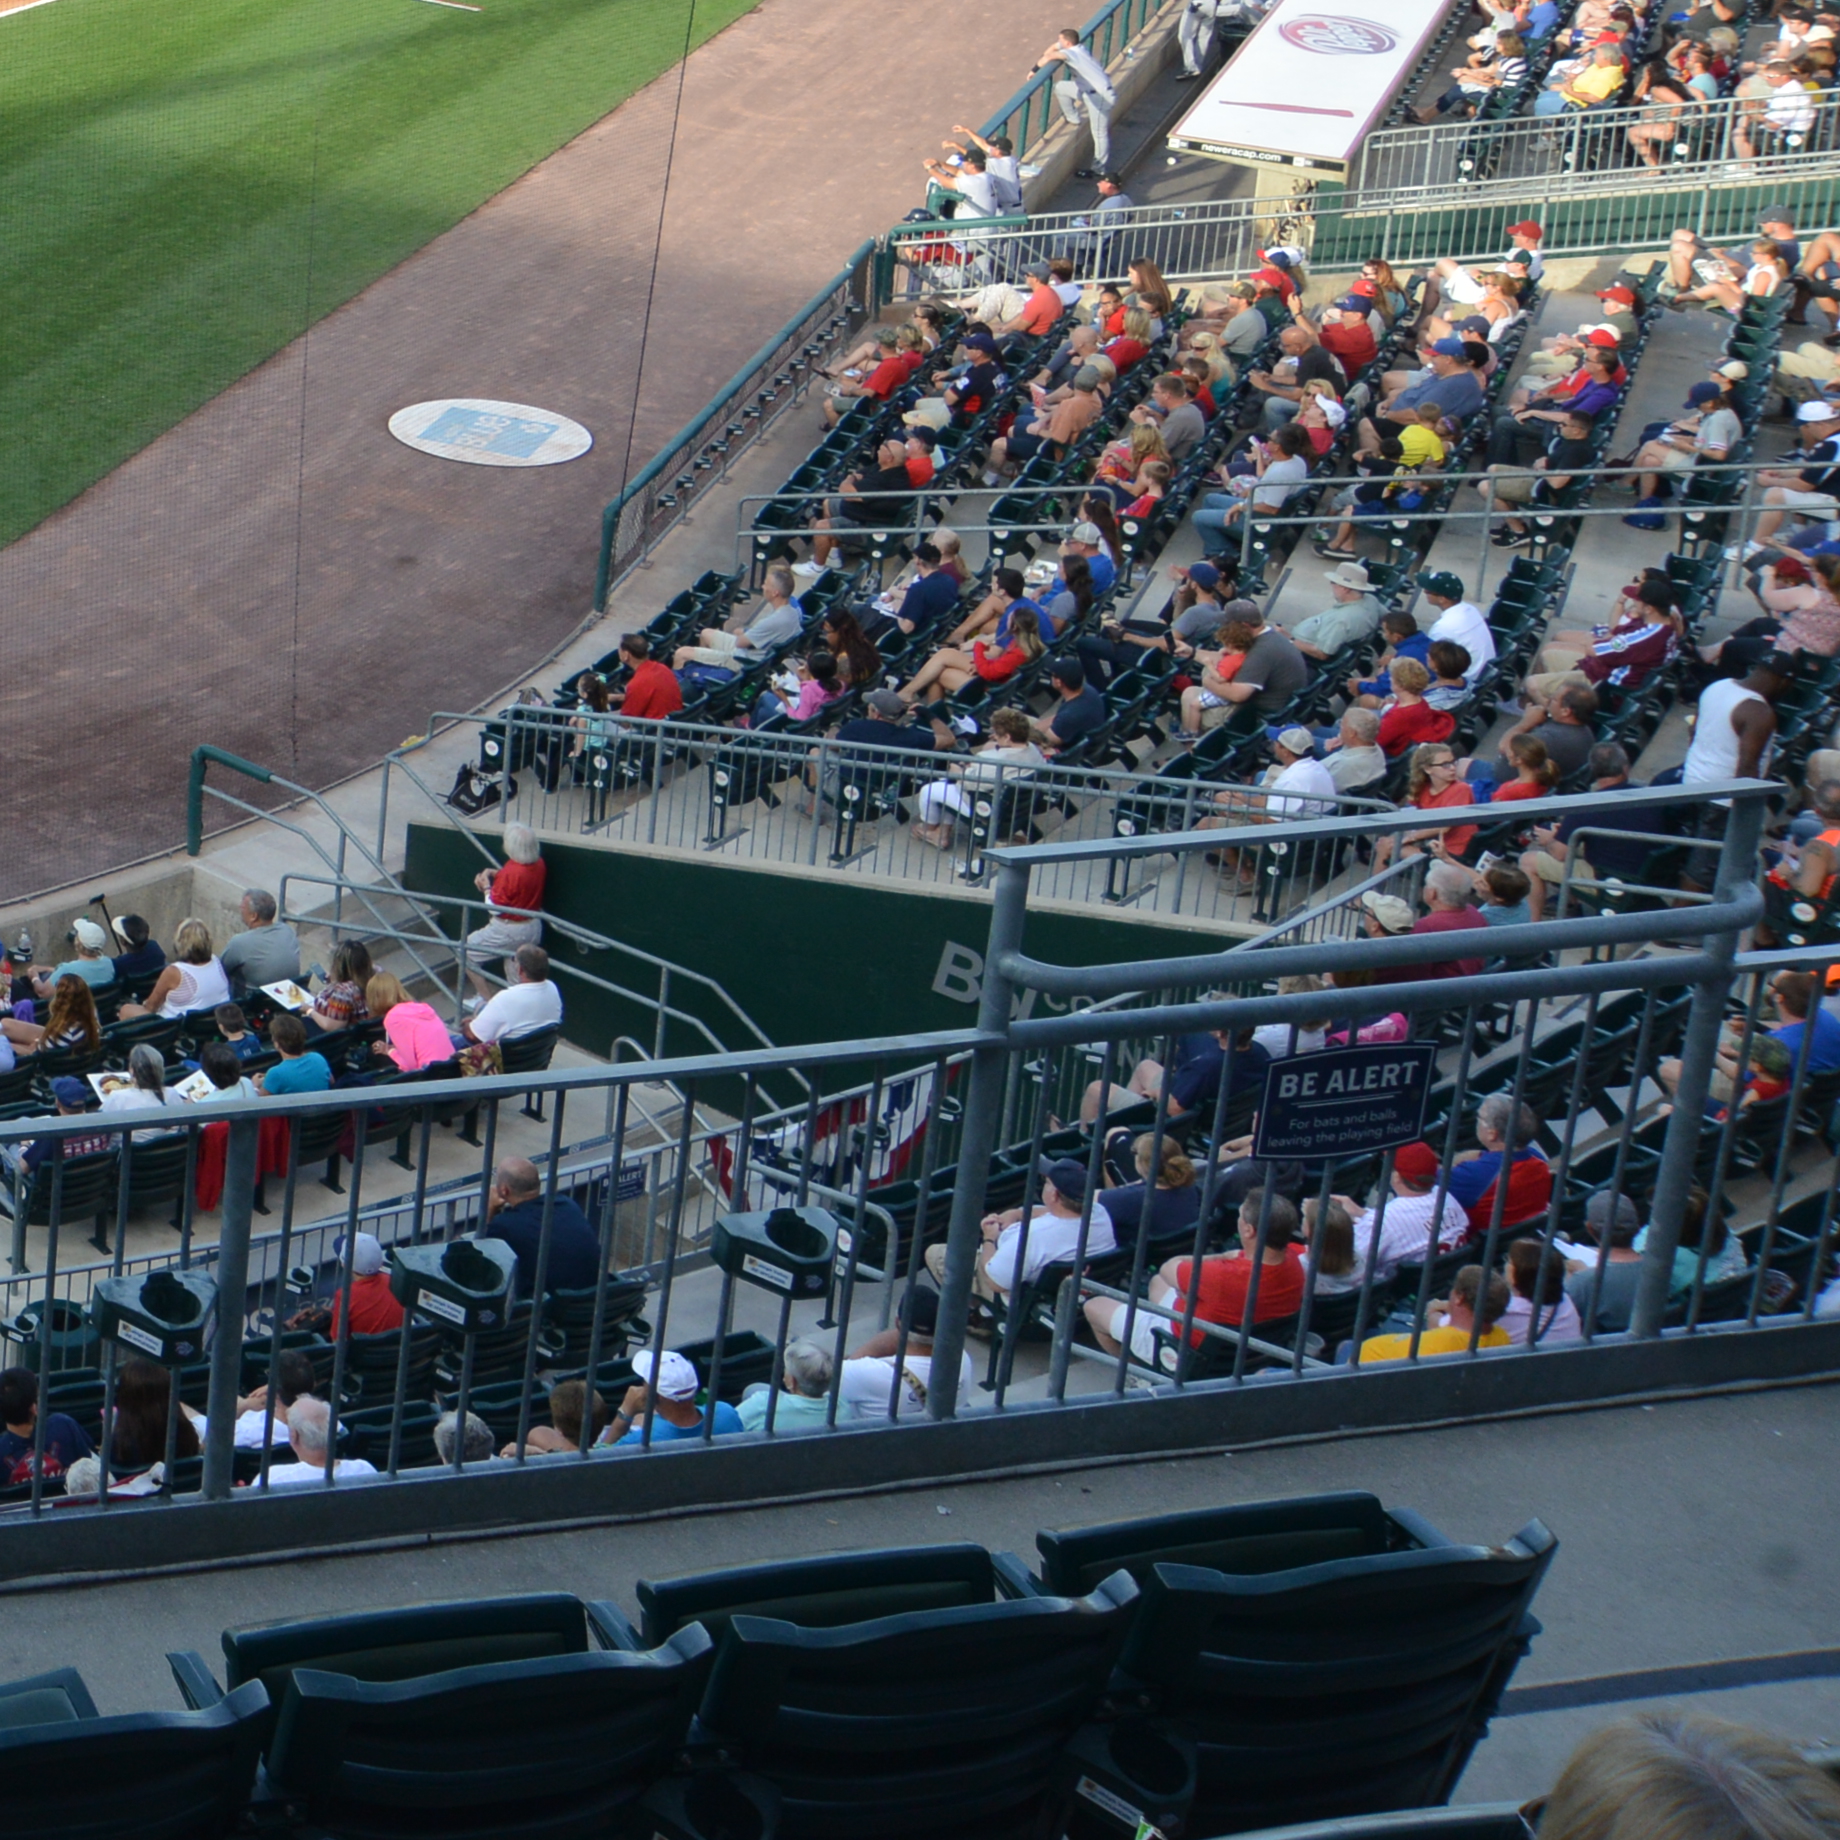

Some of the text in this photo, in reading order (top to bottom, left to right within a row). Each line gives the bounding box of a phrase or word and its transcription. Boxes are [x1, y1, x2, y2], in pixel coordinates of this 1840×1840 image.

[1200, 142, 1282, 163] neweracap.com
[1278, 1061, 1420, 1098] BE ALERT
[1288, 1108, 1398, 1132] For bats and balls
[1267, 1122, 1413, 1148] leaving the playing field
